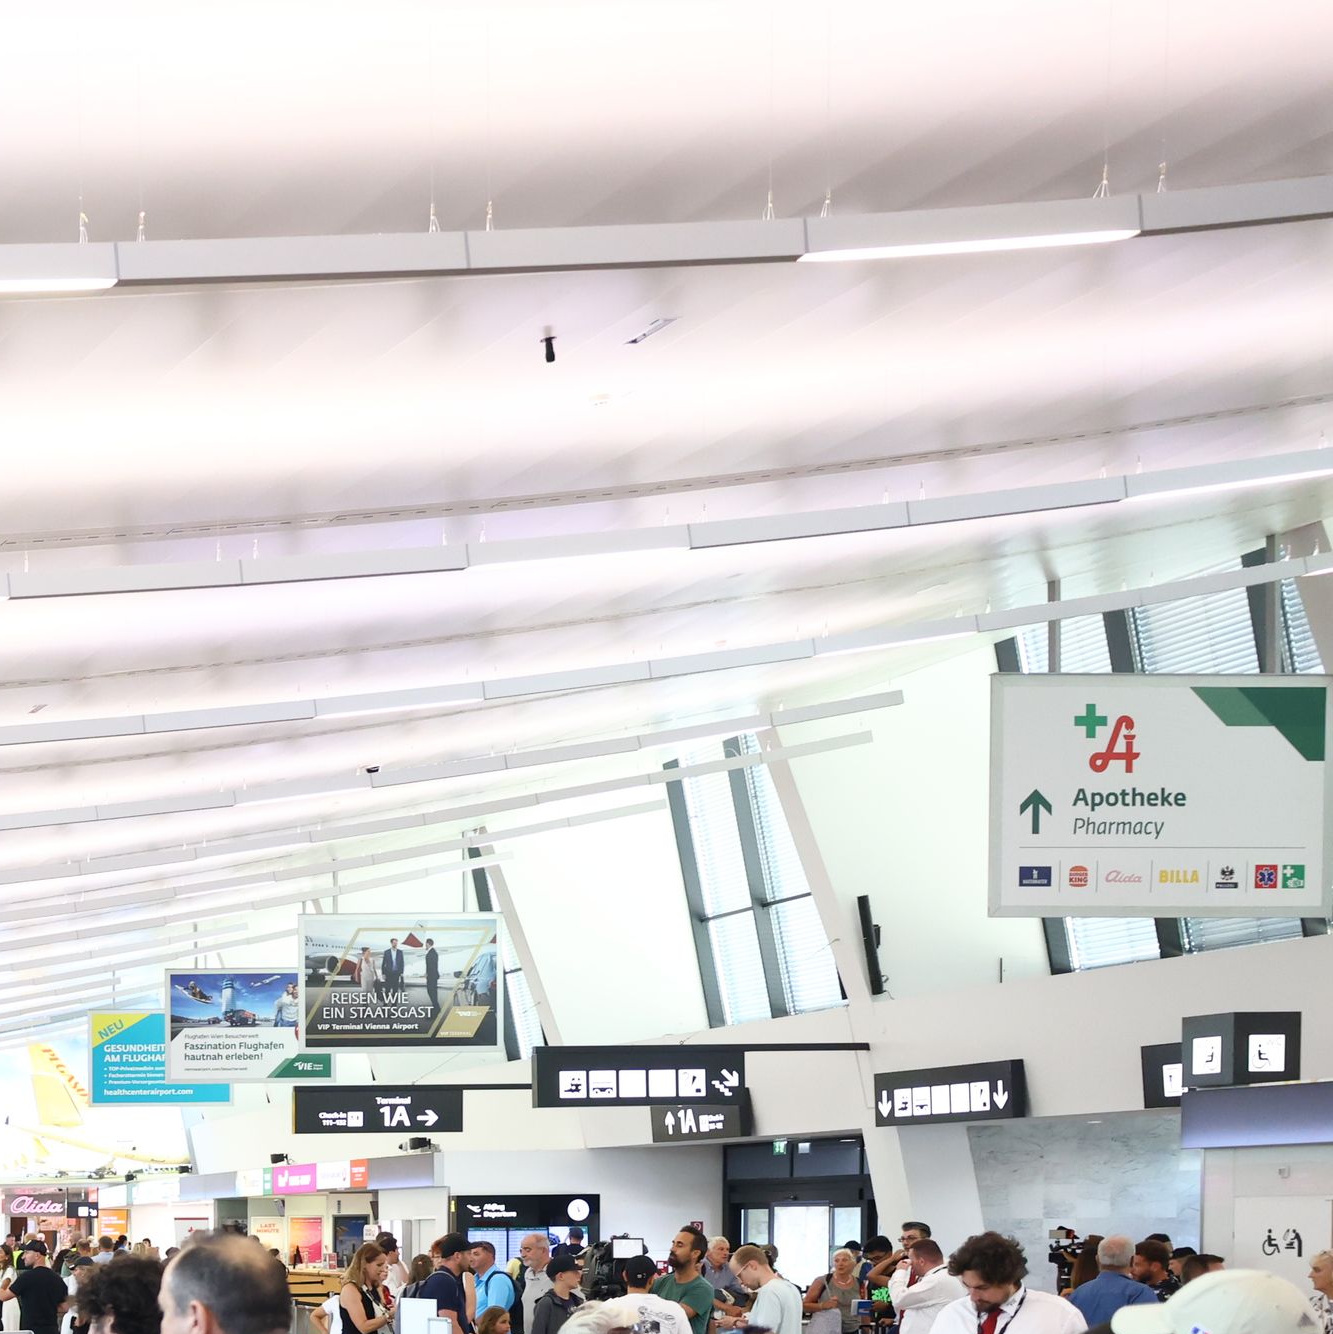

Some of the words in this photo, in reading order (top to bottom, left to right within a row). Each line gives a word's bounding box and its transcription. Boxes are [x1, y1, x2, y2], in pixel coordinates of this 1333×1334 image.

[1072, 787, 1187, 812] Apotheke
[1073, 816, 1165, 840] Pharmacy
[1069, 876, 1089, 884] KING
[1159, 869, 1199, 883] BILLA
[331, 991, 377, 1004] REISEN
[383, 991, 409, 1004] WIE
[322, 1006, 345, 1019] EIN
[349, 1005, 435, 1019] STAATSGAST
[97, 1018, 126, 1041] NEU
[317, 1023, 330, 1031] VIP
[332, 1023, 363, 1031] Terminal
[365, 1023, 390, 1031] Vienna
[392, 1022, 419, 1031] Airport
[184, 1041, 237, 1051] Faszination
[238, 1041, 285, 1052] Flughafen
[103, 1054, 121, 1062] AM
[184, 1052, 223, 1061] hautnah
[225, 1051, 264, 1061] erleben!
[297, 1062, 313, 1071] VIE
[103, 1088, 194, 1097] healthcenterairport.com
[375, 1096, 412, 1105] Terminal
[379, 1105, 412, 1127] 1A
[677, 1108, 698, 1134] 1A
